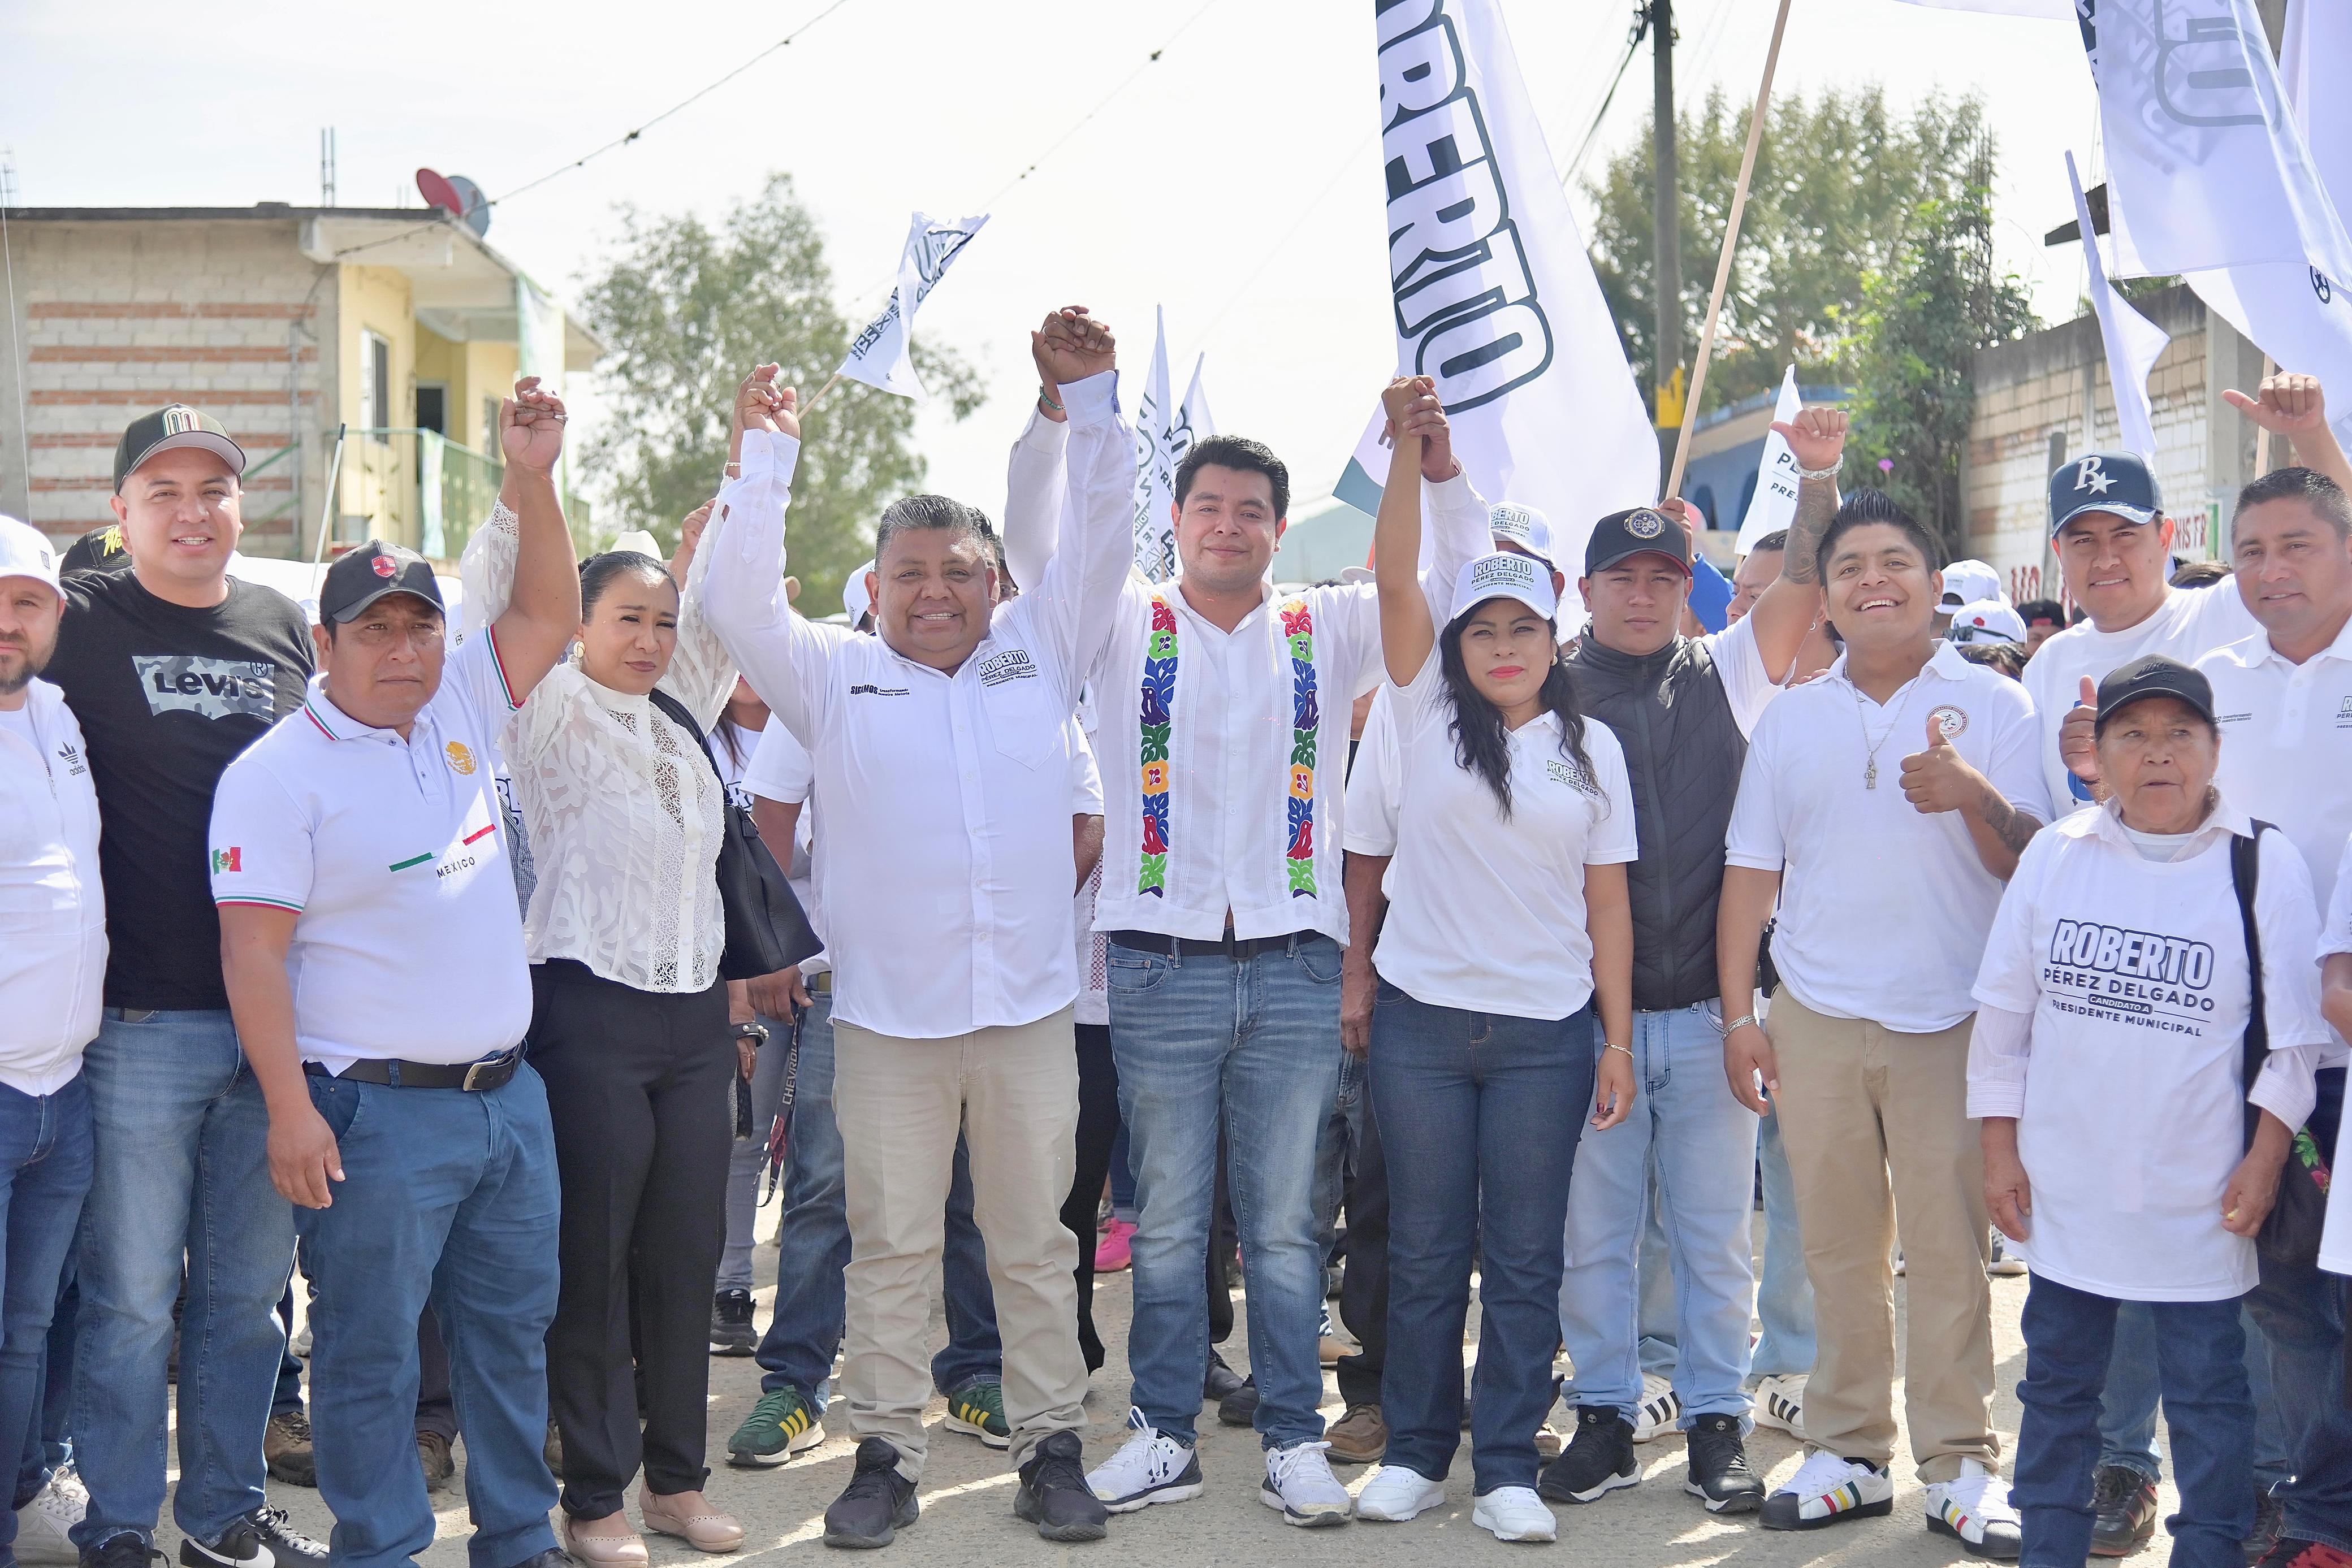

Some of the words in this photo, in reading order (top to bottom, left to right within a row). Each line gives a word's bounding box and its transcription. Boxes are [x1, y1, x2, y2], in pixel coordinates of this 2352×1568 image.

[1491, 508, 1529, 525] BERTO
[1494, 521, 1530, 531] DELGADO
[1474, 556, 1532, 578] ROBERTO
[1497, 571, 1534, 583] DELGADO
[1474, 582, 1504, 592] PRESIDENTE
[1506, 582, 1532, 591] MUNICIPAL
[978, 649, 1030, 677] ROBERTO
[1004, 664, 1036, 674] DELGADO
[987, 677, 1014, 688] PRESIDENTE
[70, 764, 87, 776] adidas
[1568, 779, 1599, 796] DELGADO
[436, 856, 475, 878] MEXICO
[2050, 918, 2215, 990] ROBERTO
[2044, 967, 2102, 990] PÉREZ
[2108, 979, 2215, 1012] DELGADO
[2090, 996, 2141, 1011] CANDIDATO
[2052, 999, 2121, 1022] PRESIDENTE
[2125, 1015, 2202, 1037] MUNICIPAL
